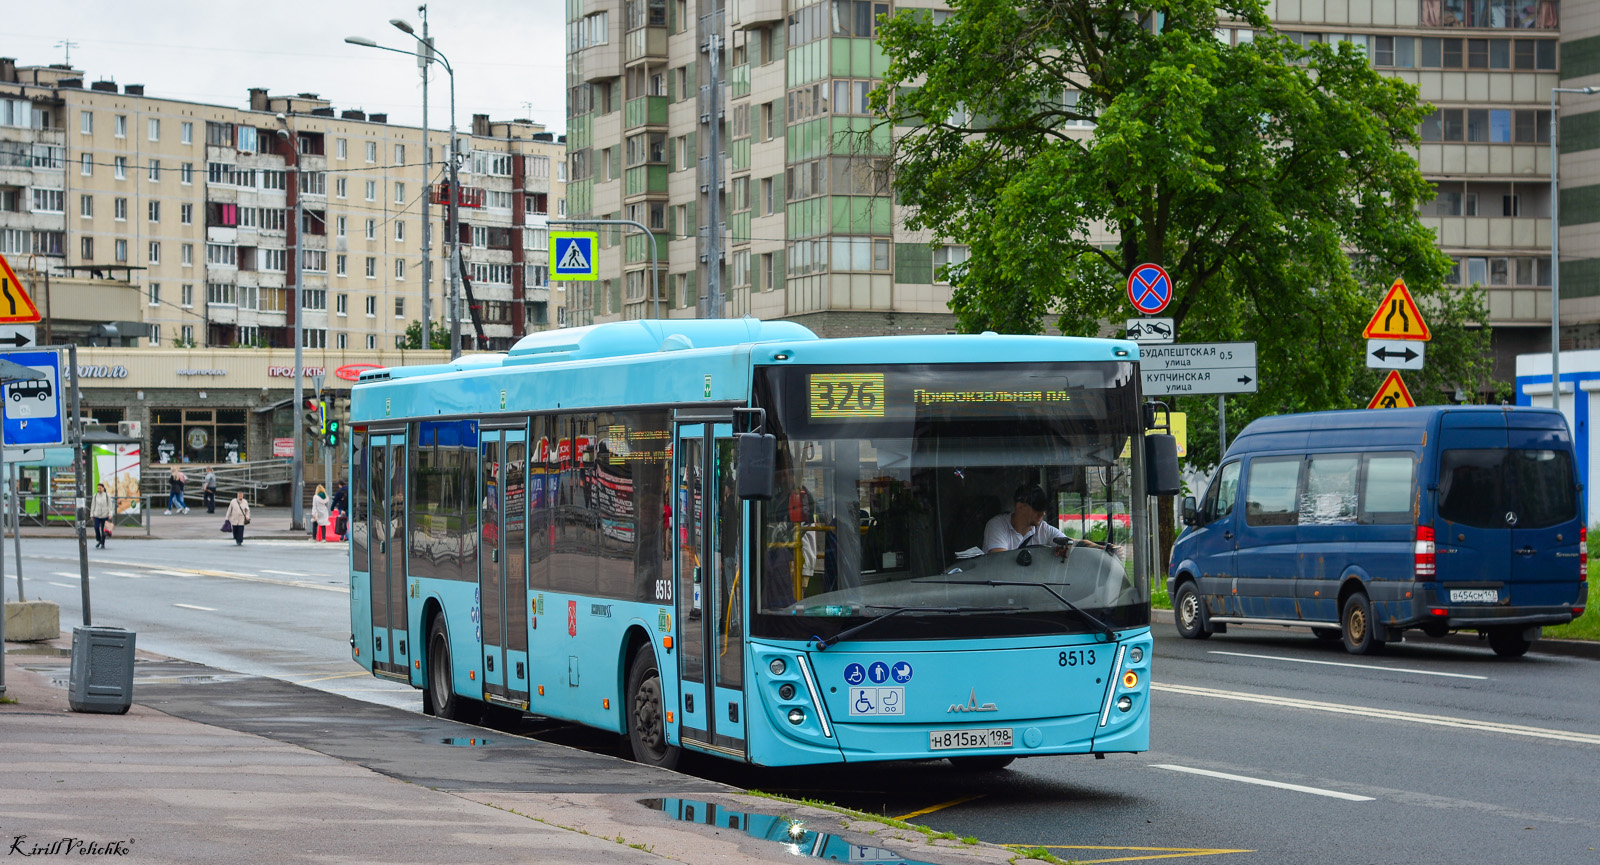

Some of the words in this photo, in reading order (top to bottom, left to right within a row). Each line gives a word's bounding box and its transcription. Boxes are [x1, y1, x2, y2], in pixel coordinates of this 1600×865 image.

[1139, 347, 1216, 358] БУДАПЕШТСКАЯ
[1165, 360, 1191, 368] улица
[1146, 372, 1211, 382] КУПЧИНСКАЯ
[1166, 384, 1192, 393] улица
[817, 381, 876, 410] 326
[913, 389, 1042, 406] Привокзальная
[1046, 391, 1071, 401] пл.
[655, 579, 672, 600] 8513
[1058, 650, 1096, 667] 8513
[989, 729, 1009, 741] 198
